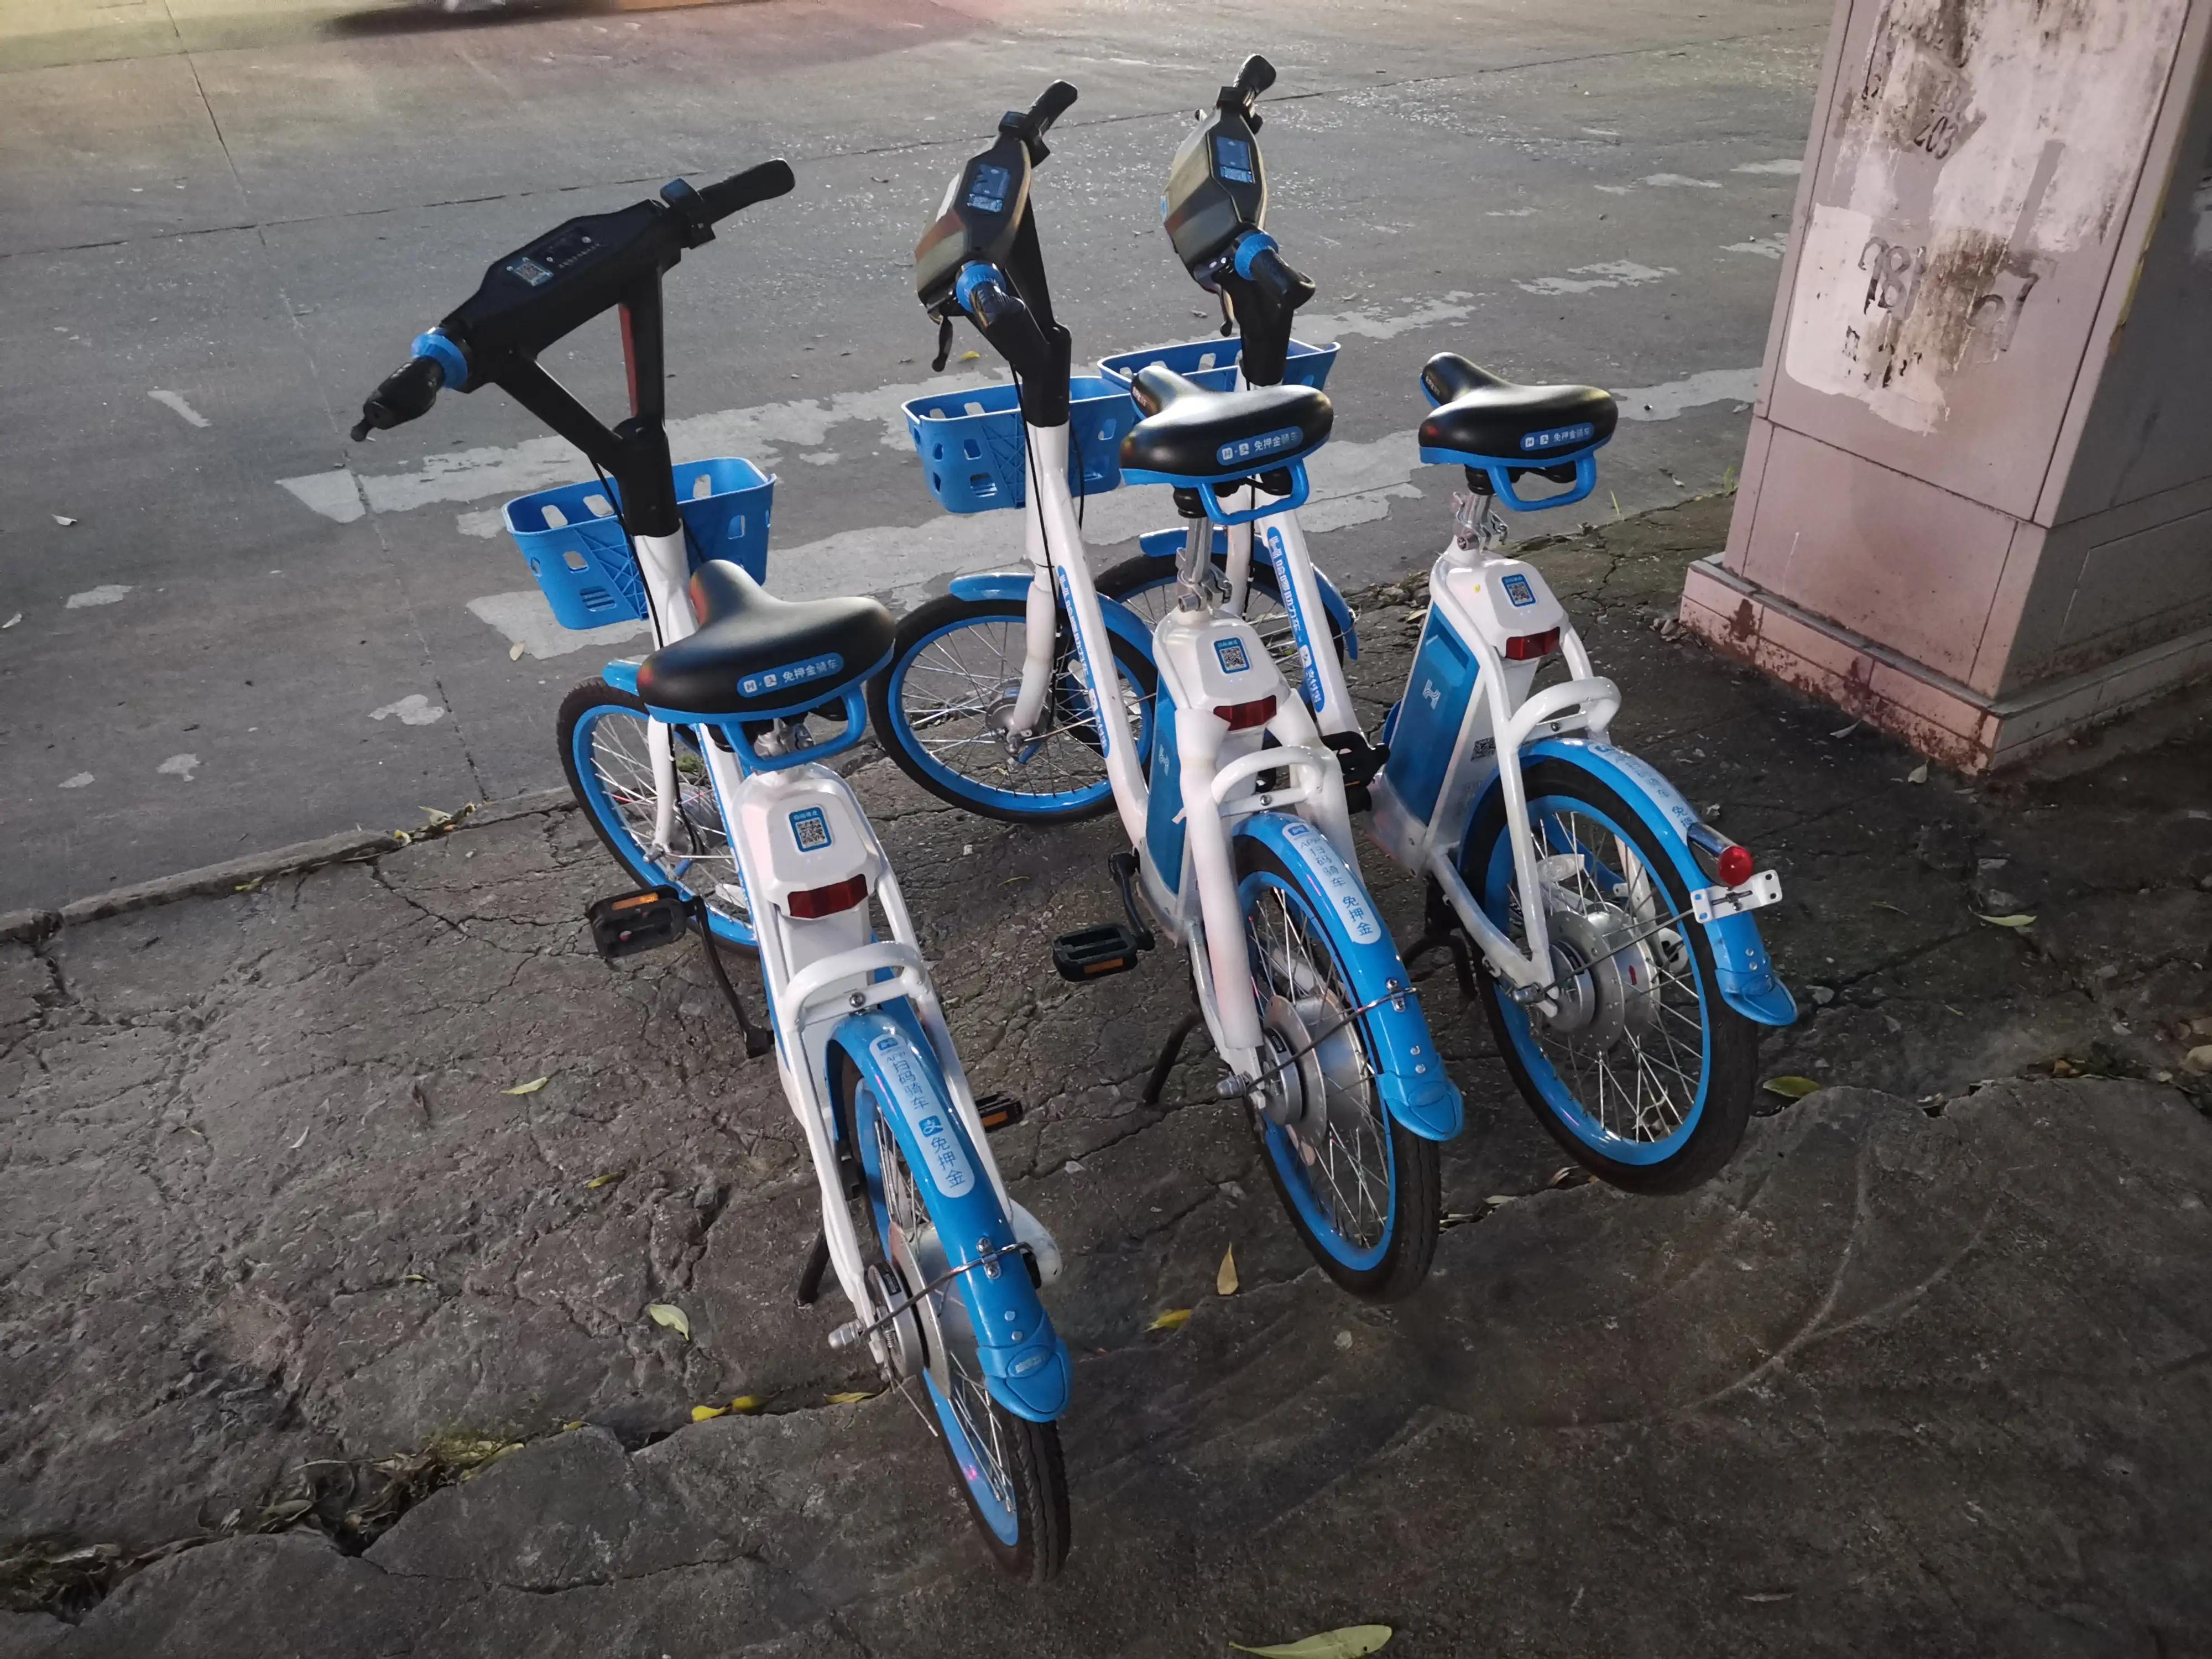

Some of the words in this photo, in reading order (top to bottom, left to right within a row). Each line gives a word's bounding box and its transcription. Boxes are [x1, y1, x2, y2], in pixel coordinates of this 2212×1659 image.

[782, 659, 838, 683] 免押金骑车
[1343, 896, 1373, 935] 免押金
[931, 1137, 965, 1188] 免押金
